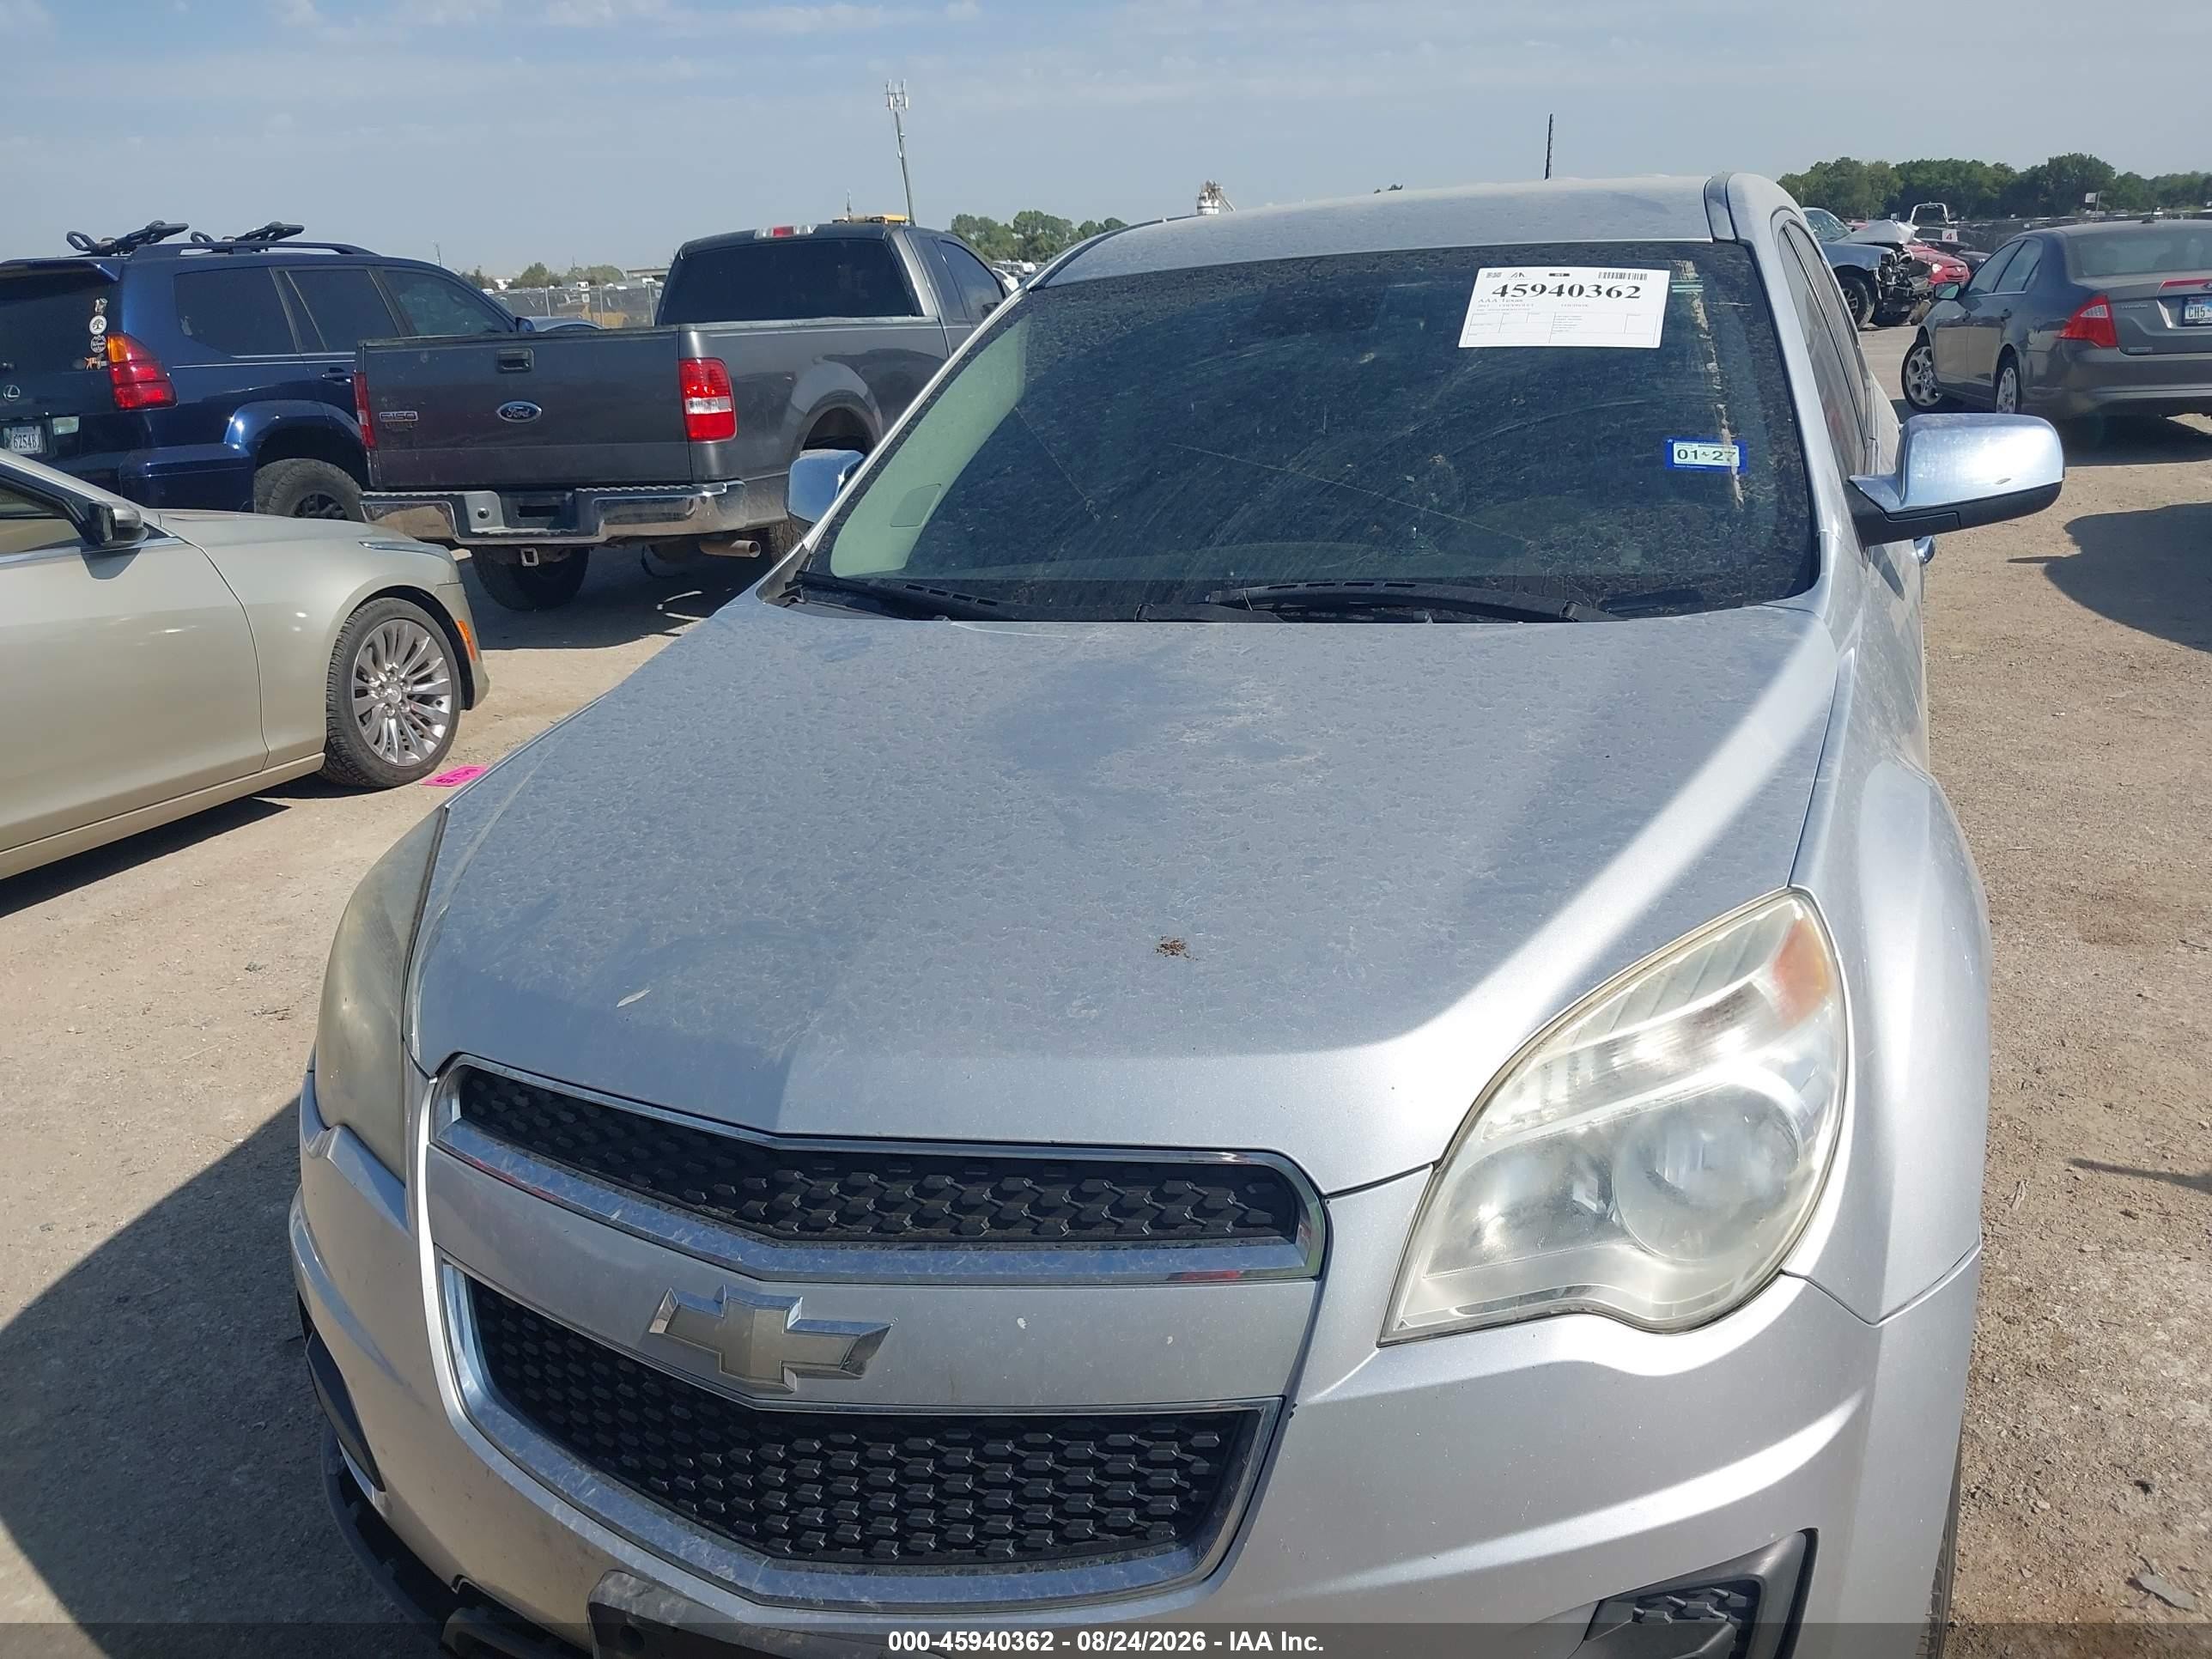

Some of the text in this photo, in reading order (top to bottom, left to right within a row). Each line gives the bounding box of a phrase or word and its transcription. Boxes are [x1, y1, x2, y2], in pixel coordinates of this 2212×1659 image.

[1491, 283, 1642, 299] 45940362
[506, 406, 530, 418] Ford
[1676, 448, 1698, 460] 01
